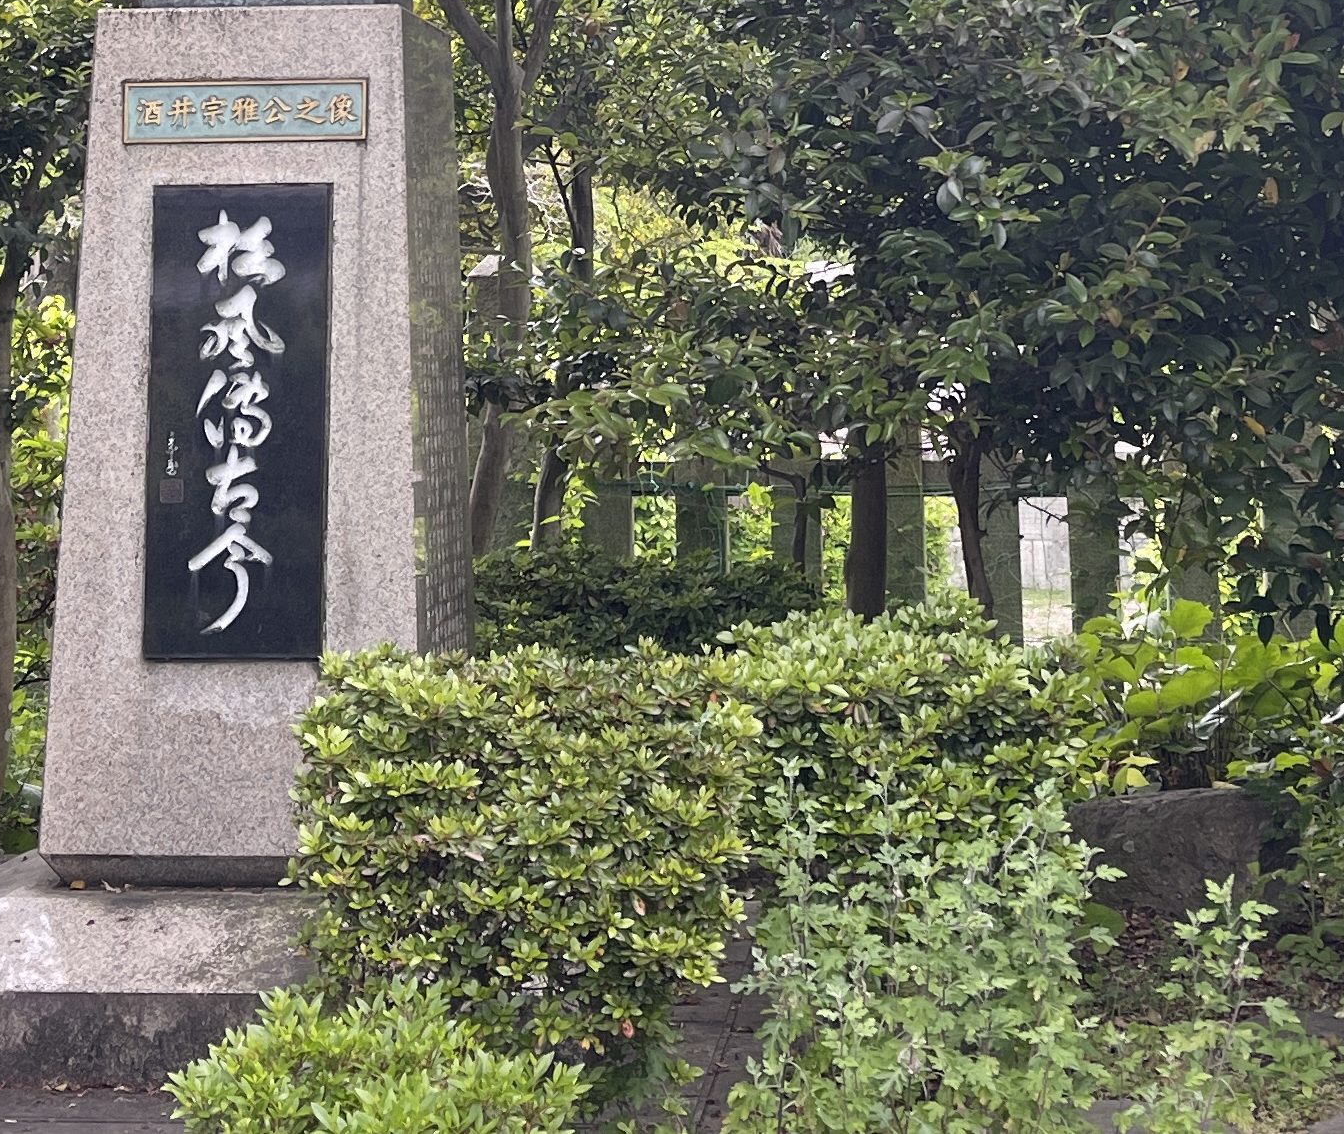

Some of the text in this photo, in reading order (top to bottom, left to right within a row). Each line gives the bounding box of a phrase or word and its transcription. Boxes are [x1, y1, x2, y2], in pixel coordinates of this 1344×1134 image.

[135, 92, 359, 128] 酒井宗雅公之像
